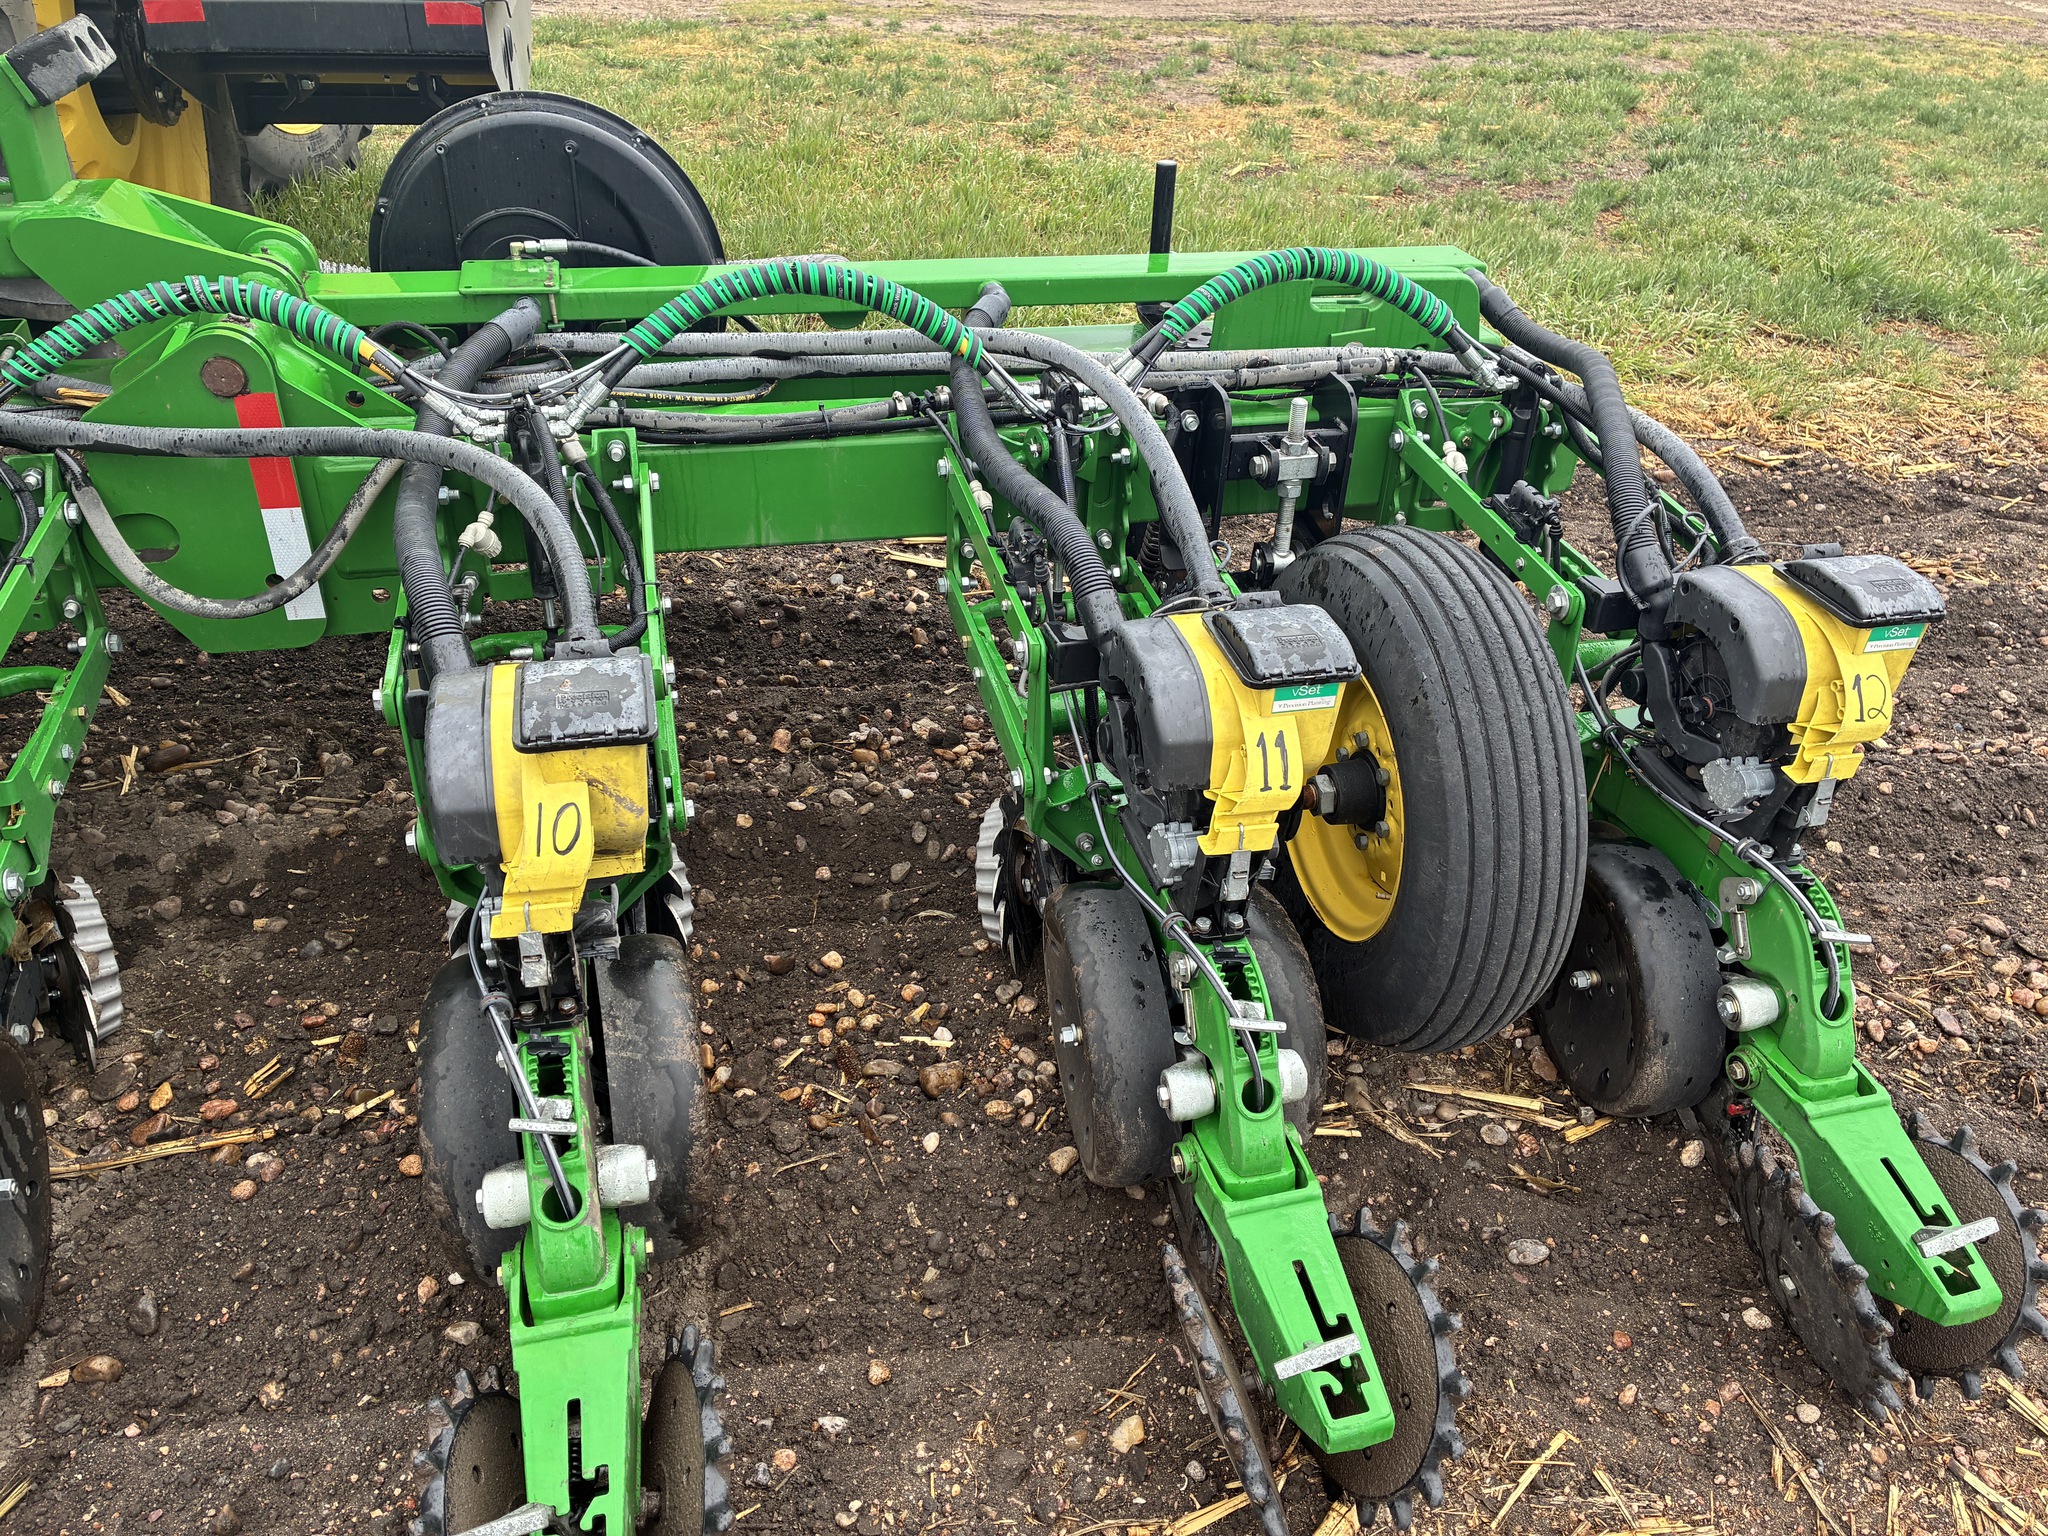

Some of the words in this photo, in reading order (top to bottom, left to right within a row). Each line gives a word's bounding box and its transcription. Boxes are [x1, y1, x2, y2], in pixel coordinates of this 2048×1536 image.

[1884, 626, 1909, 638] vSet
[1282, 700, 1307, 709] Precision
[1291, 684, 1322, 697] vSet
[1852, 673, 1888, 722] 12
[1256, 730, 1291, 792] 11
[536, 802, 582, 857] 10
